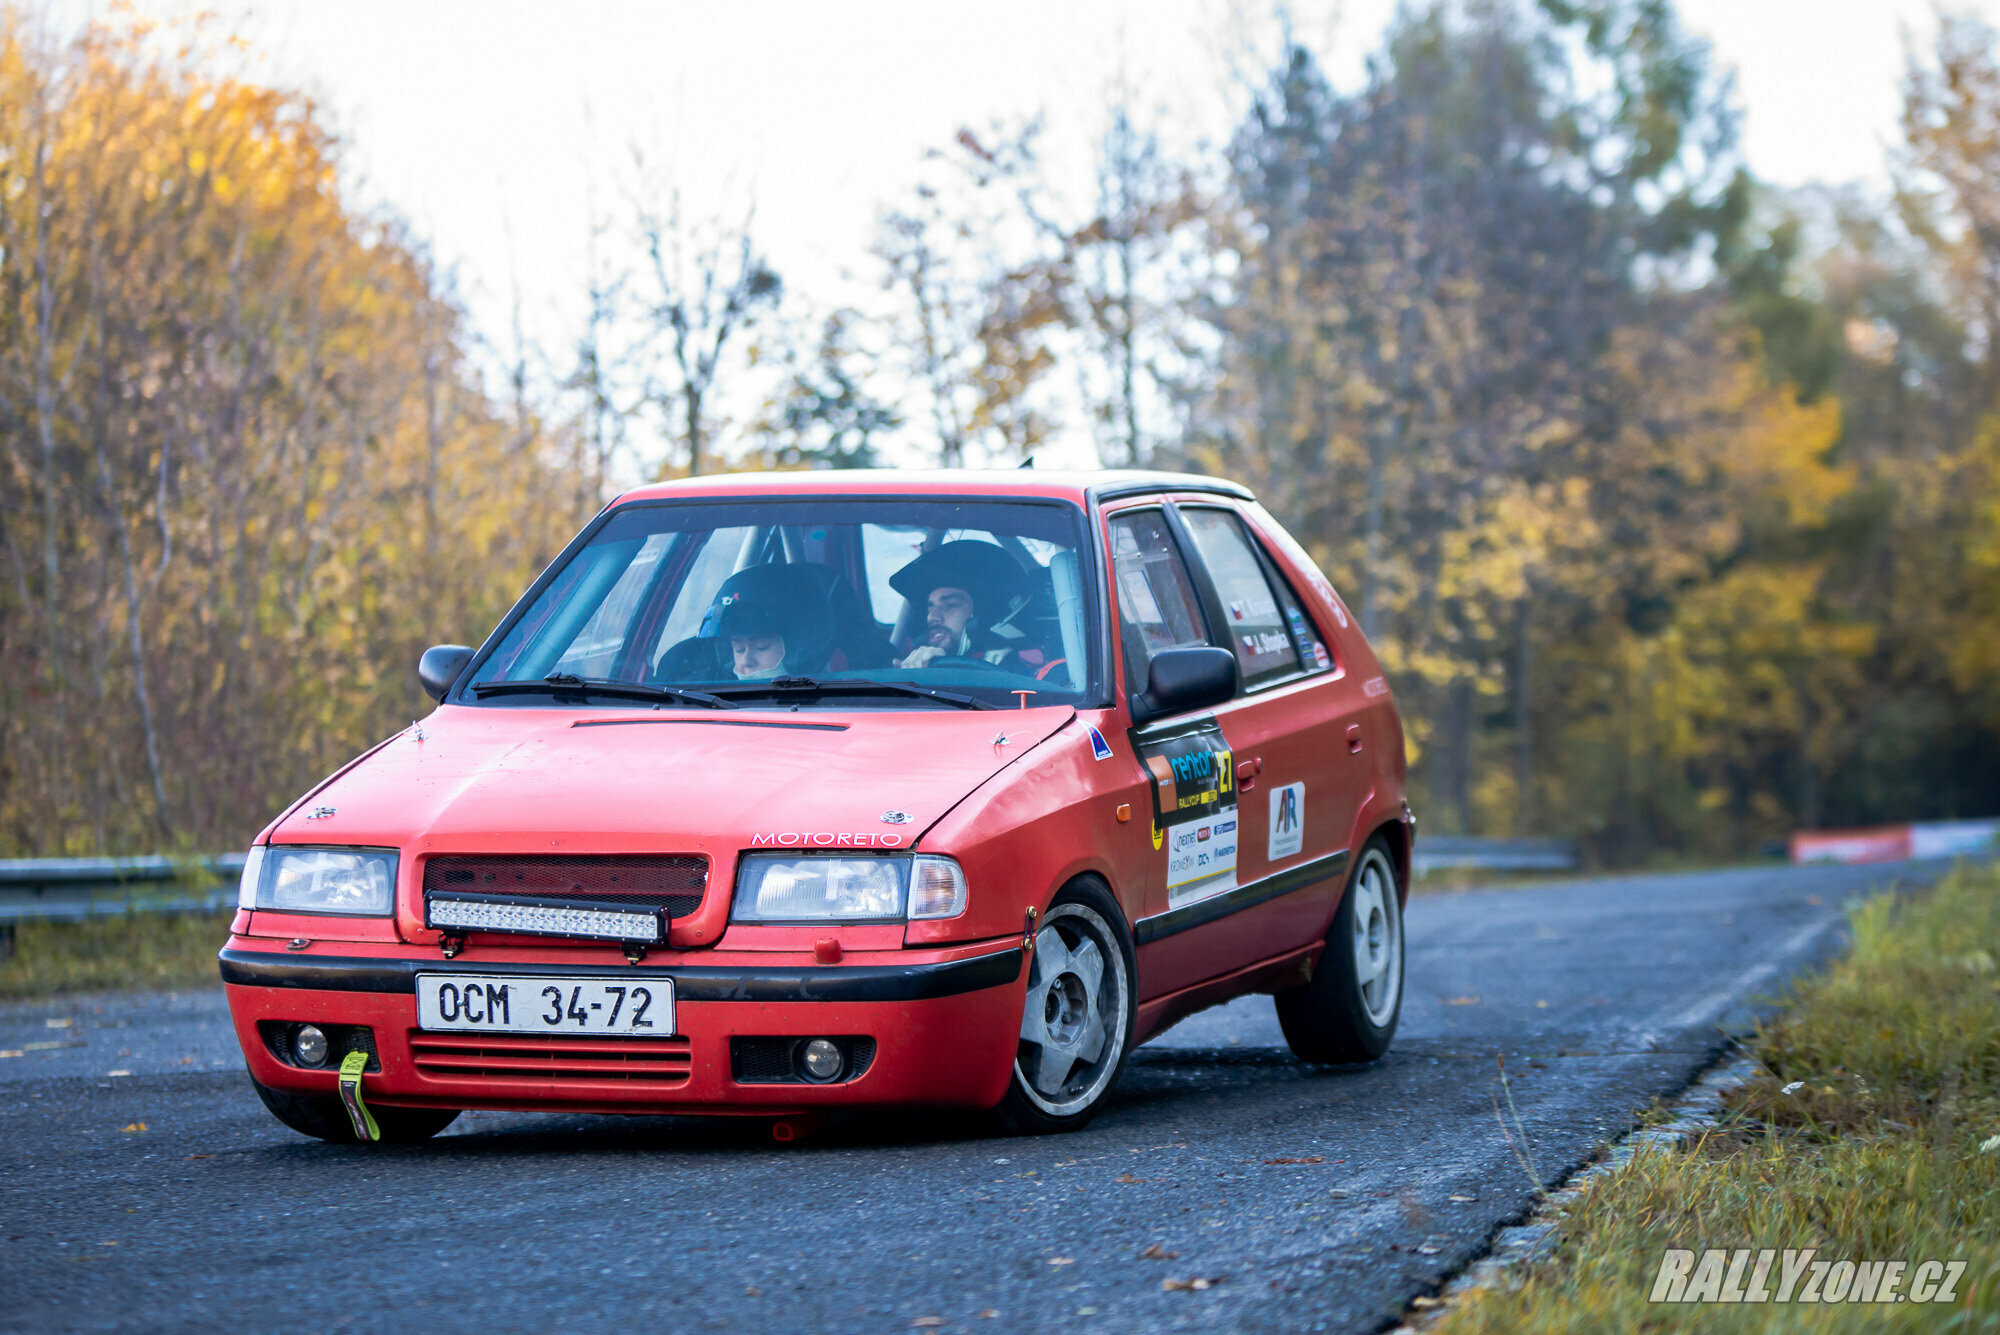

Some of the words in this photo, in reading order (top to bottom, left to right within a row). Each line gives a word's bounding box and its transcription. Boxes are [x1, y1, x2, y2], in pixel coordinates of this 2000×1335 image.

[1171, 750, 1211, 783] rentor
[1214, 750, 1232, 793] 27
[1276, 788, 1298, 834] AR
[751, 832, 902, 847] MOTORETO
[438, 982, 510, 1024] OCM
[541, 986, 653, 1028] 34-72
